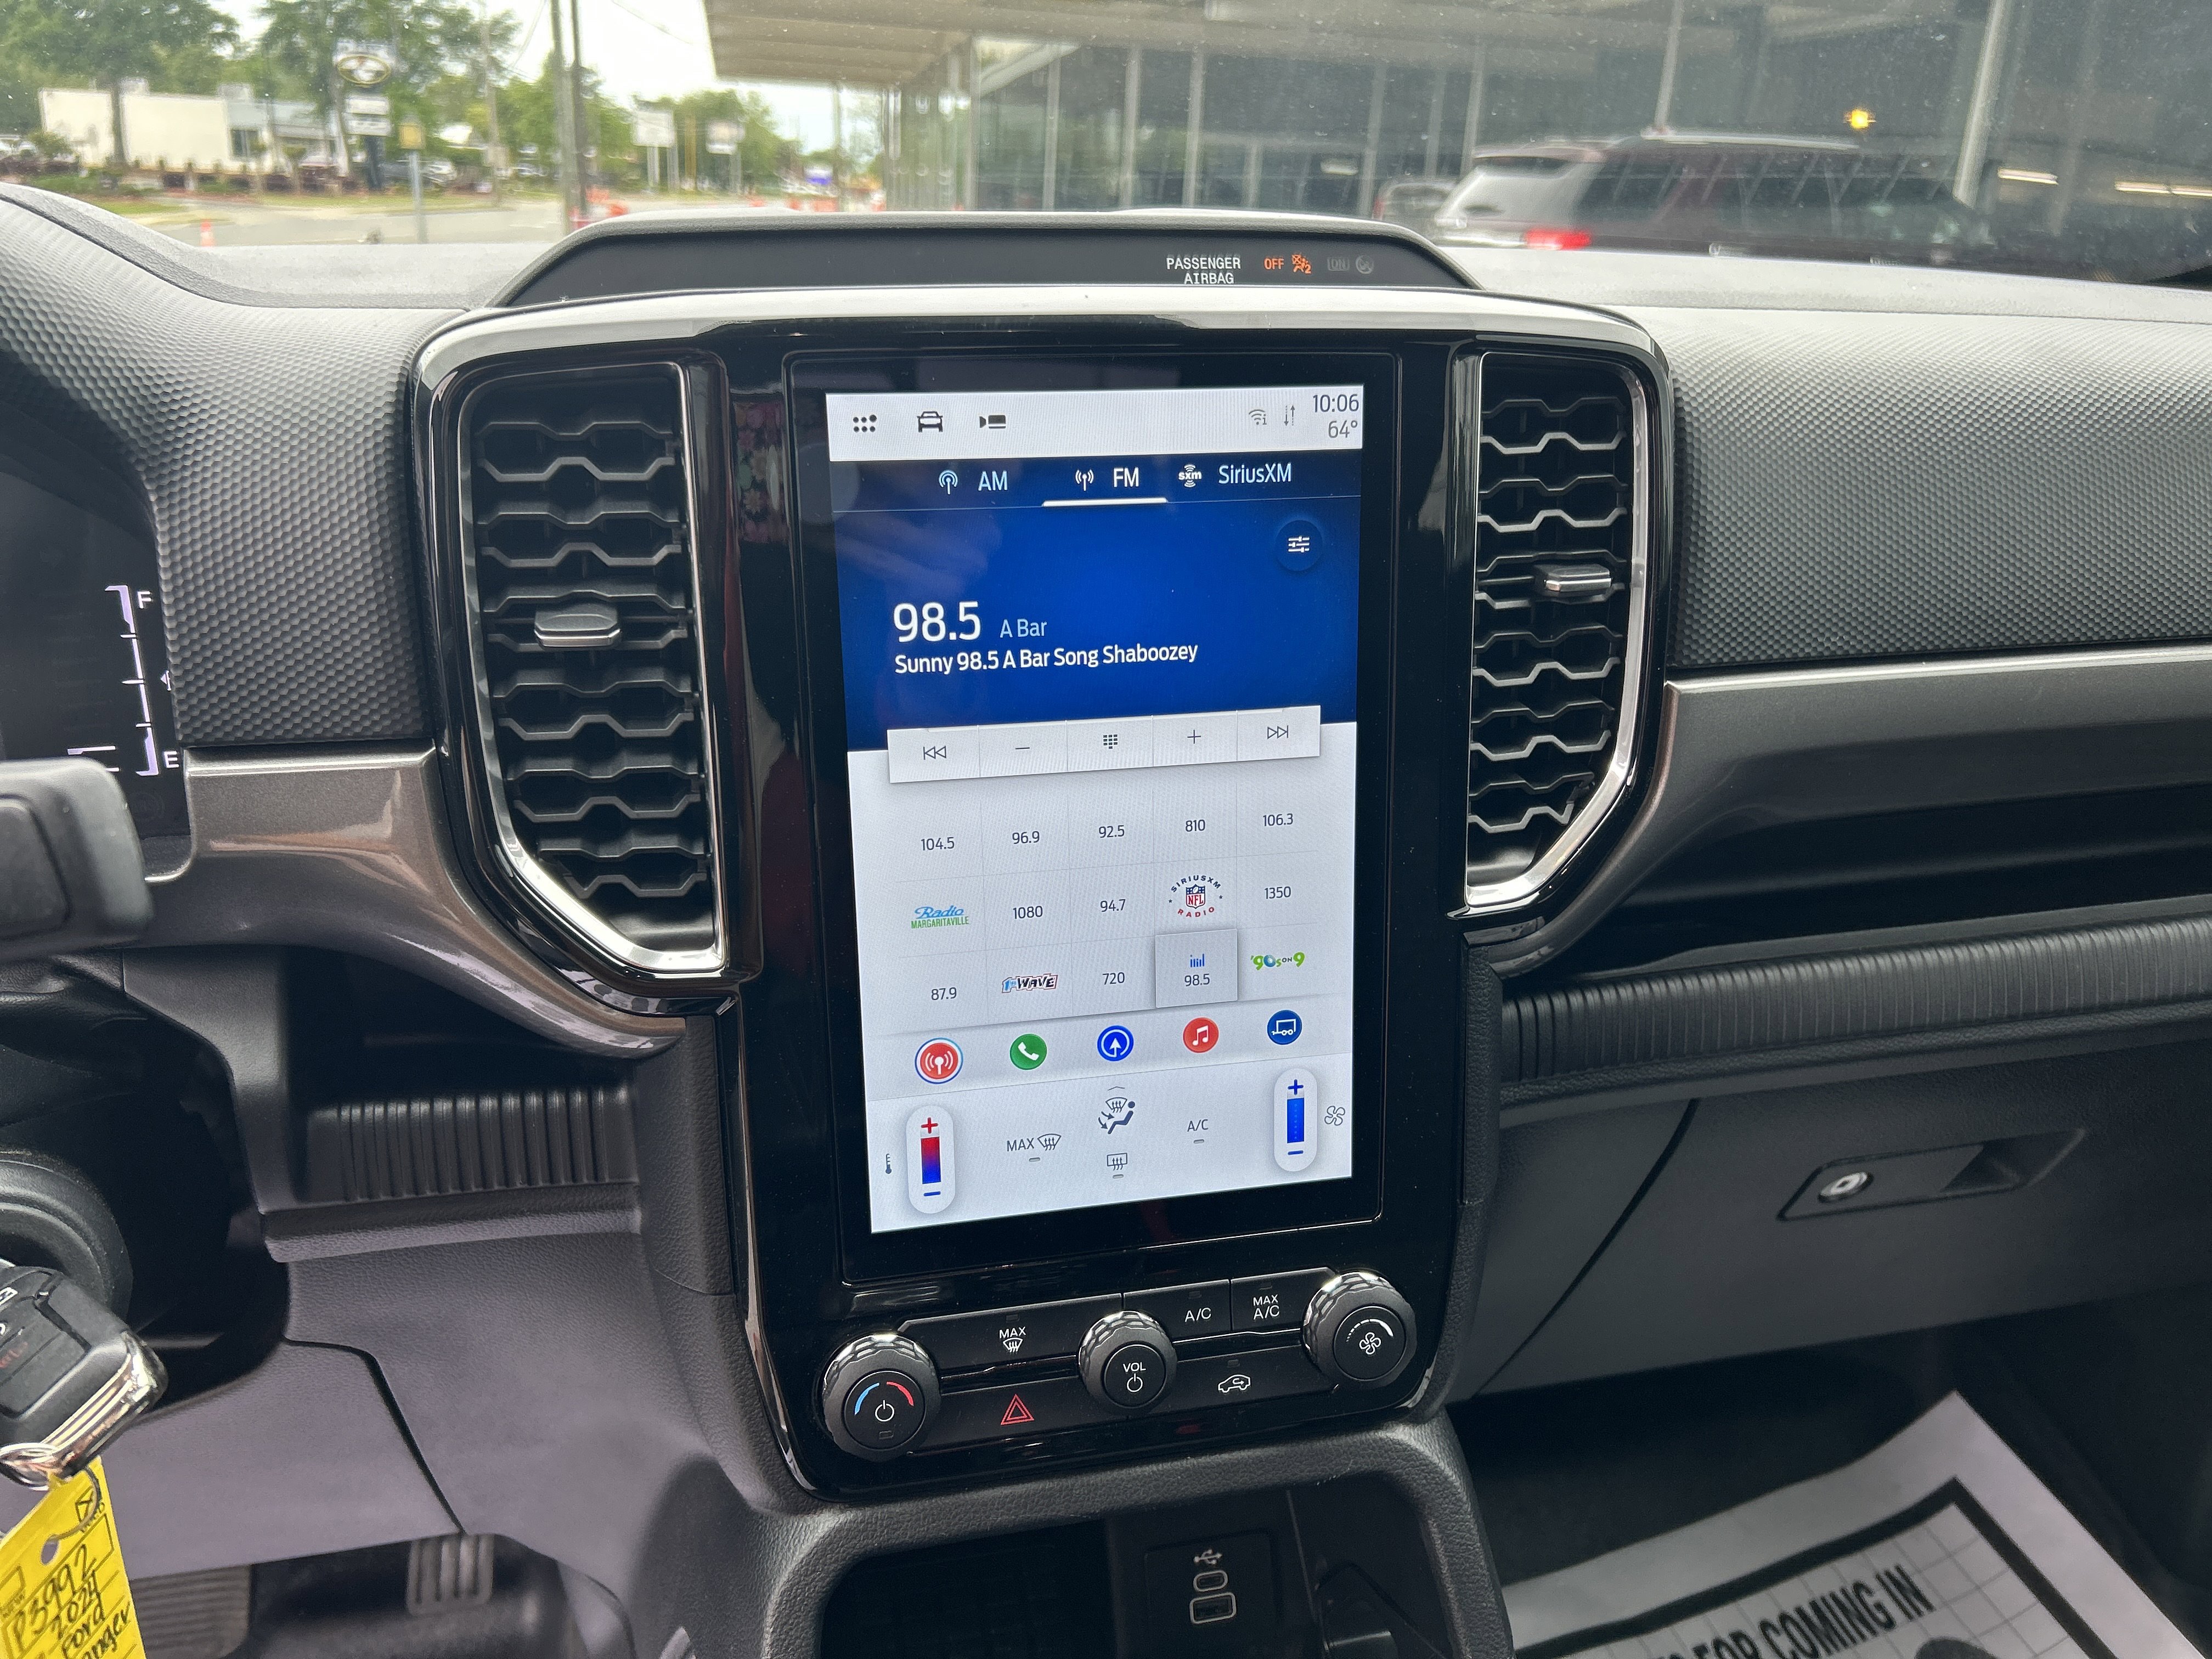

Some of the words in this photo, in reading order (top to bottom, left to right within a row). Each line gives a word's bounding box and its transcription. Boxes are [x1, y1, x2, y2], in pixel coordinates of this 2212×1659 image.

[1166, 258, 1242, 269] PASSENGER
[1263, 258, 1284, 269] OFF
[1184, 272, 1234, 284] AIRBAG
[1312, 393, 1359, 413] 10:06
[1113, 467, 1139, 488] FM
[1218, 462, 1291, 484] SiriusXM
[978, 470, 1008, 491] AM
[137, 591, 153, 609] F
[893, 601, 981, 642] 98.5
[1000, 619, 1013, 638] A
[1017, 618, 1047, 637] Bar
[895, 654, 953, 675] Sunny
[957, 650, 999, 671] 98.5
[1002, 650, 1017, 669] A
[1020, 649, 1051, 668] Bar
[1054, 647, 1099, 668] Song
[1102, 643, 1198, 664] Shaboozey
[163, 751, 179, 769] E
[1185, 819, 1206, 832] 810
[1262, 813, 1294, 827] 106.3
[1012, 831, 1040, 844] 96.9
[1098, 825, 1125, 838] 92.5
[921, 837, 955, 851] 104.5
[1171, 875, 1221, 893] SIRIUSXM
[1264, 886, 1291, 900] 1350
[1100, 899, 1126, 912] 94.7
[1188, 895, 1204, 906] NFL
[915, 906, 964, 919] Radio
[1013, 905, 1043, 919] 1080
[1177, 906, 1215, 918] RADIO
[911, 916, 970, 929] MARGARITAVILLE
[1293, 952, 1305, 968] 9
[1017, 977, 1056, 989] WAVE
[1102, 972, 1125, 985] 720
[1184, 973, 1210, 987] 98.5
[931, 987, 957, 1001] 87.9
[1187, 1119, 1209, 1132] A/C
[1007, 1137, 1035, 1152] MAX
[1253, 1294, 1279, 1306] MAX
[1184, 1307, 1211, 1322] A/C
[1253, 1303, 1280, 1320] A/C
[999, 1326, 1026, 1338] MAX
[1122, 1362, 1147, 1374] VOL
[1758, 1579, 1897, 1659] COMING
[1874, 1564, 1936, 1621] IN
